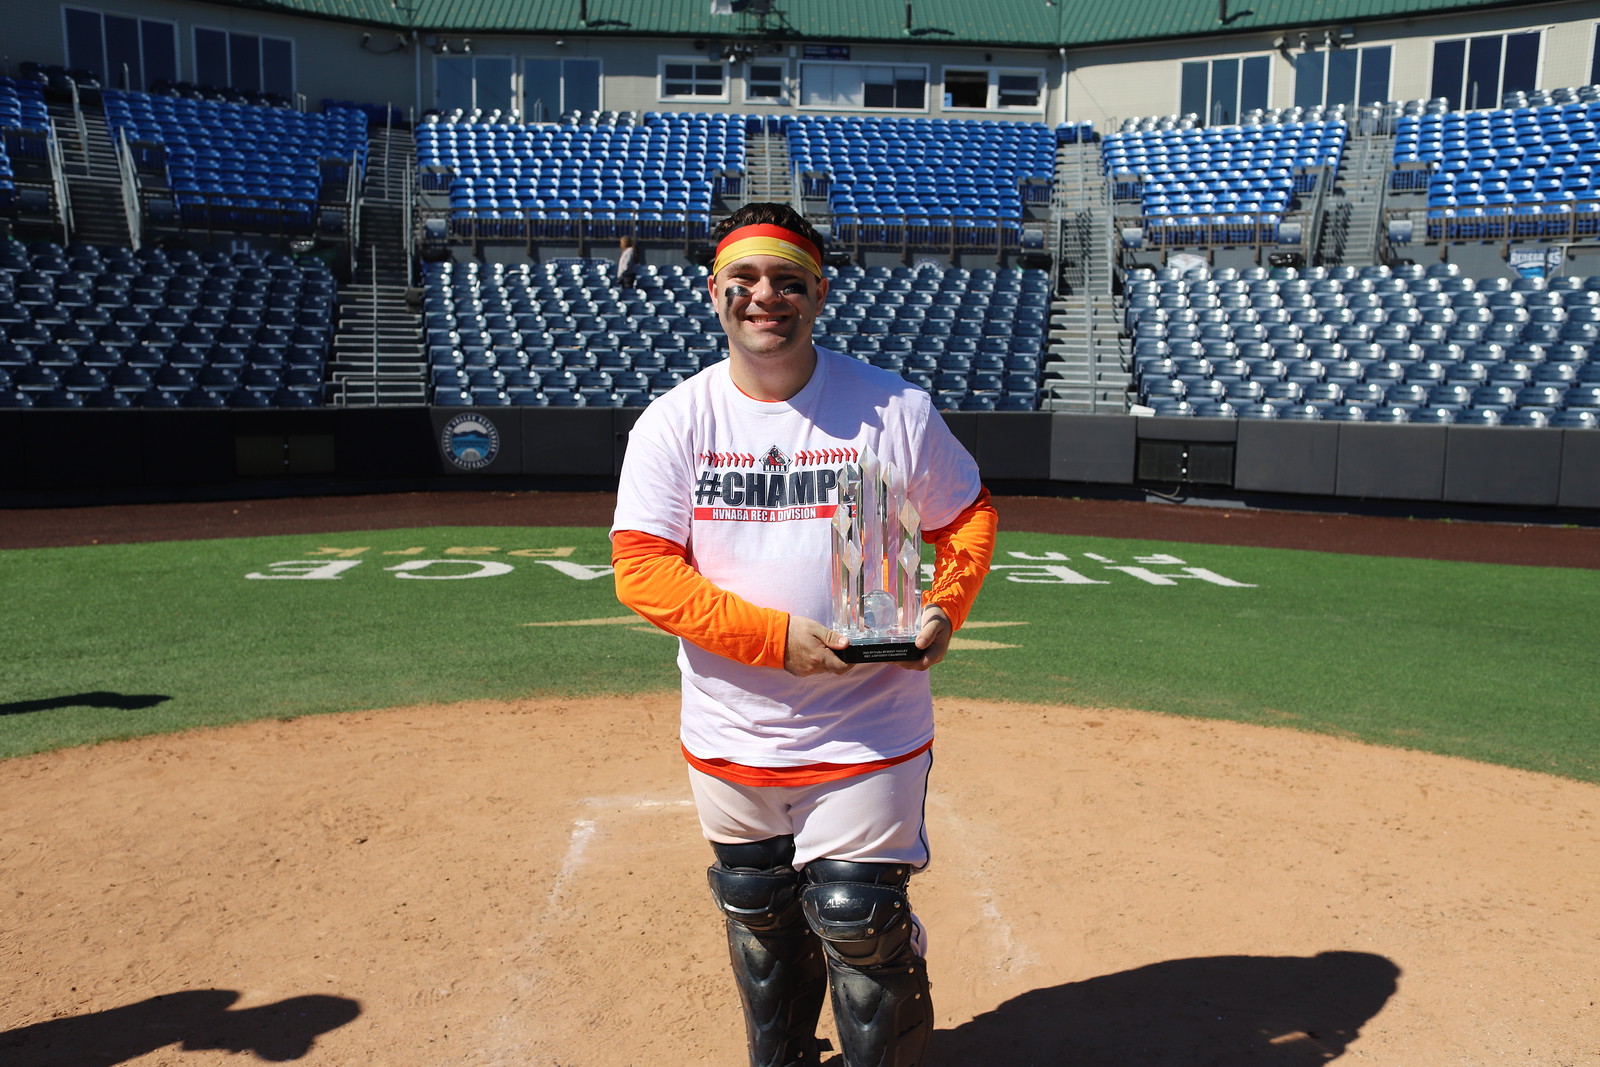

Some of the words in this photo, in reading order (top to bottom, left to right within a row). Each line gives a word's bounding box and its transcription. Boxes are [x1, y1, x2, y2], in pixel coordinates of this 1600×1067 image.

[1510, 252, 1562, 266] RENEGAES
[712, 508, 749, 521] HVNABA
[751, 510, 768, 522] REC
[769, 511, 776, 522] A
[777, 507, 816, 521] DIVISION
